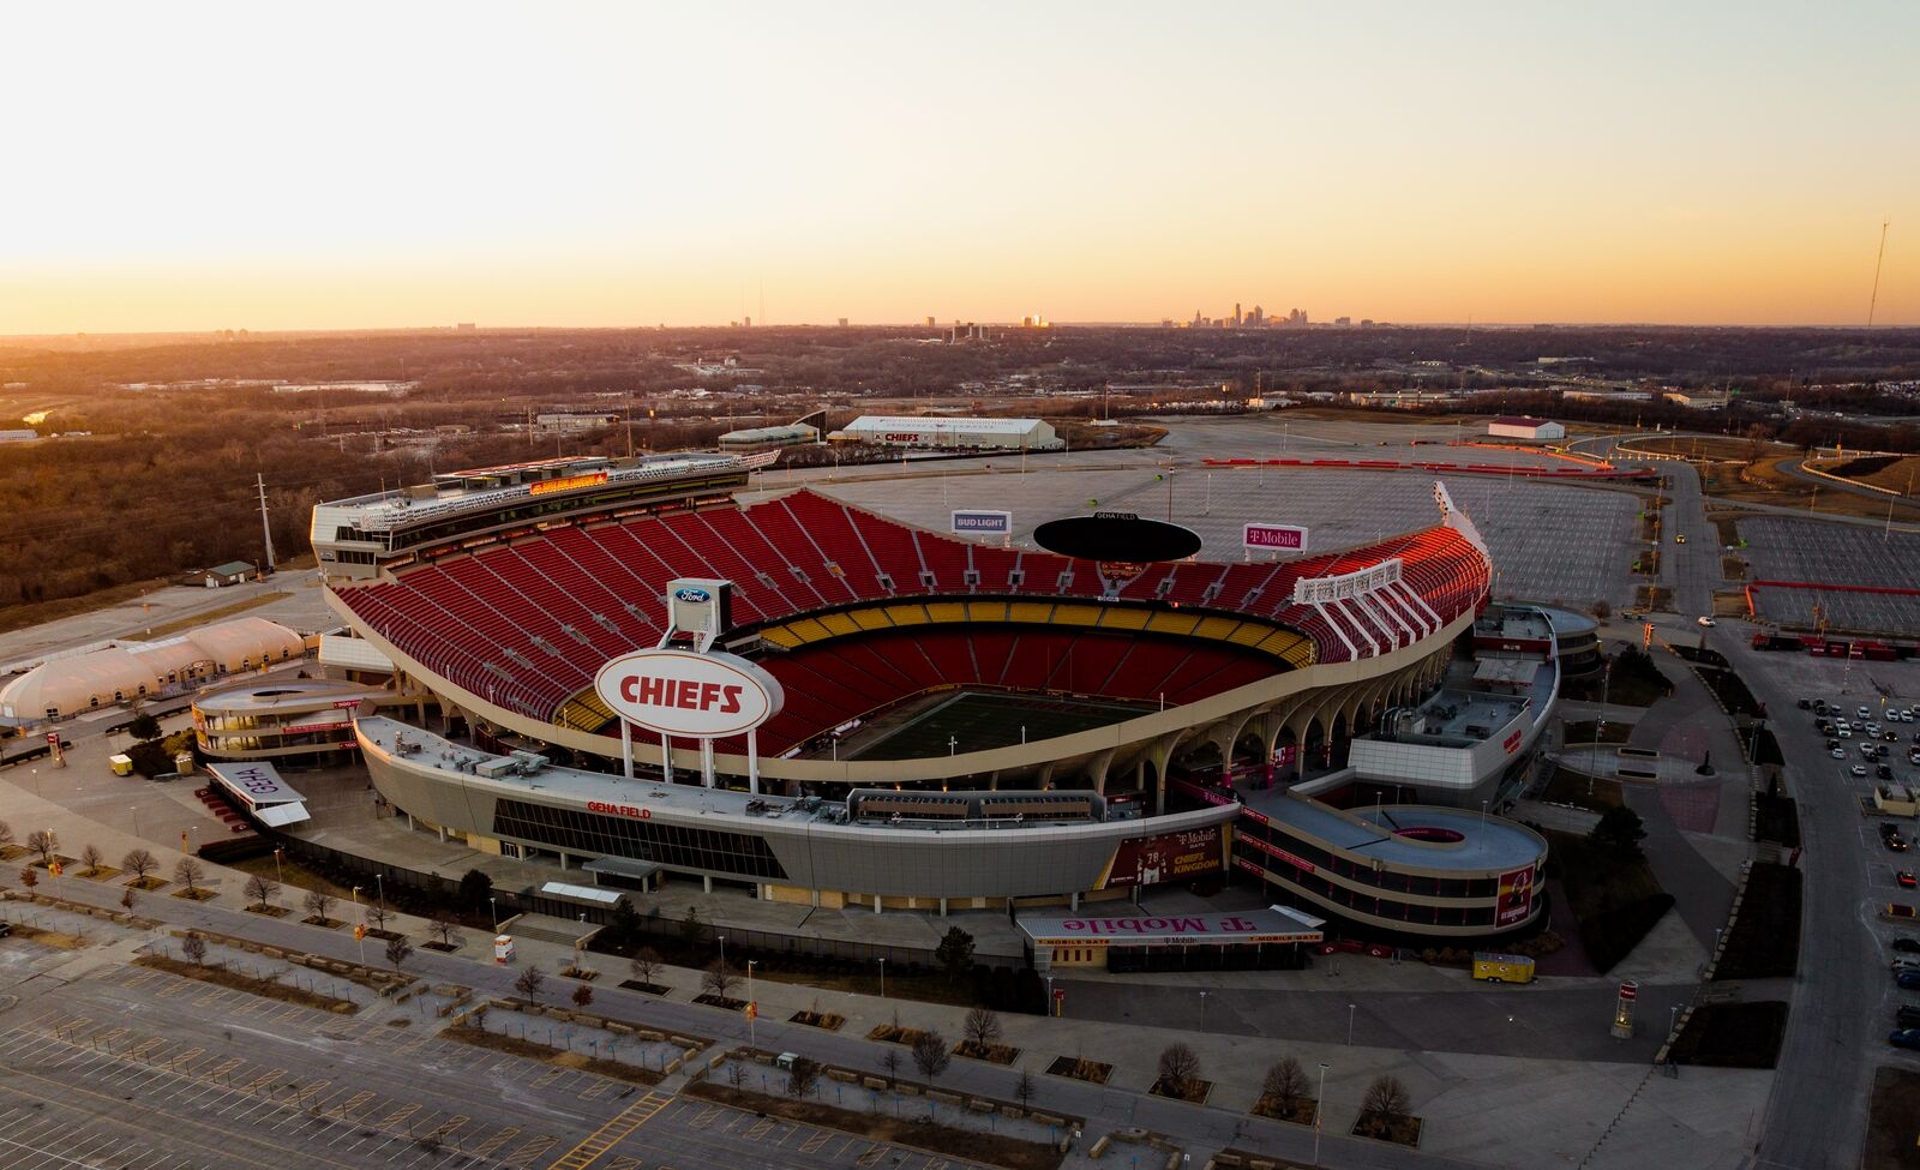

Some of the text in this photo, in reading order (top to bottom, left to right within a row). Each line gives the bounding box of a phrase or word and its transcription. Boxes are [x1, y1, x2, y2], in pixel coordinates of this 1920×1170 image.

[885, 433, 919, 442] CHIEFS
[957, 518, 1004, 528] BUD LIGHT
[680, 590, 704, 602] Ford
[620, 675, 743, 714] CHIEFS
[235, 767, 279, 795] GEHA
[588, 801, 652, 819] GEHA FIELD
[1147, 852, 1159, 864] 78
[1174, 852, 1205, 865] CHIEFS
[1173, 859, 1219, 875] KINGDOM
